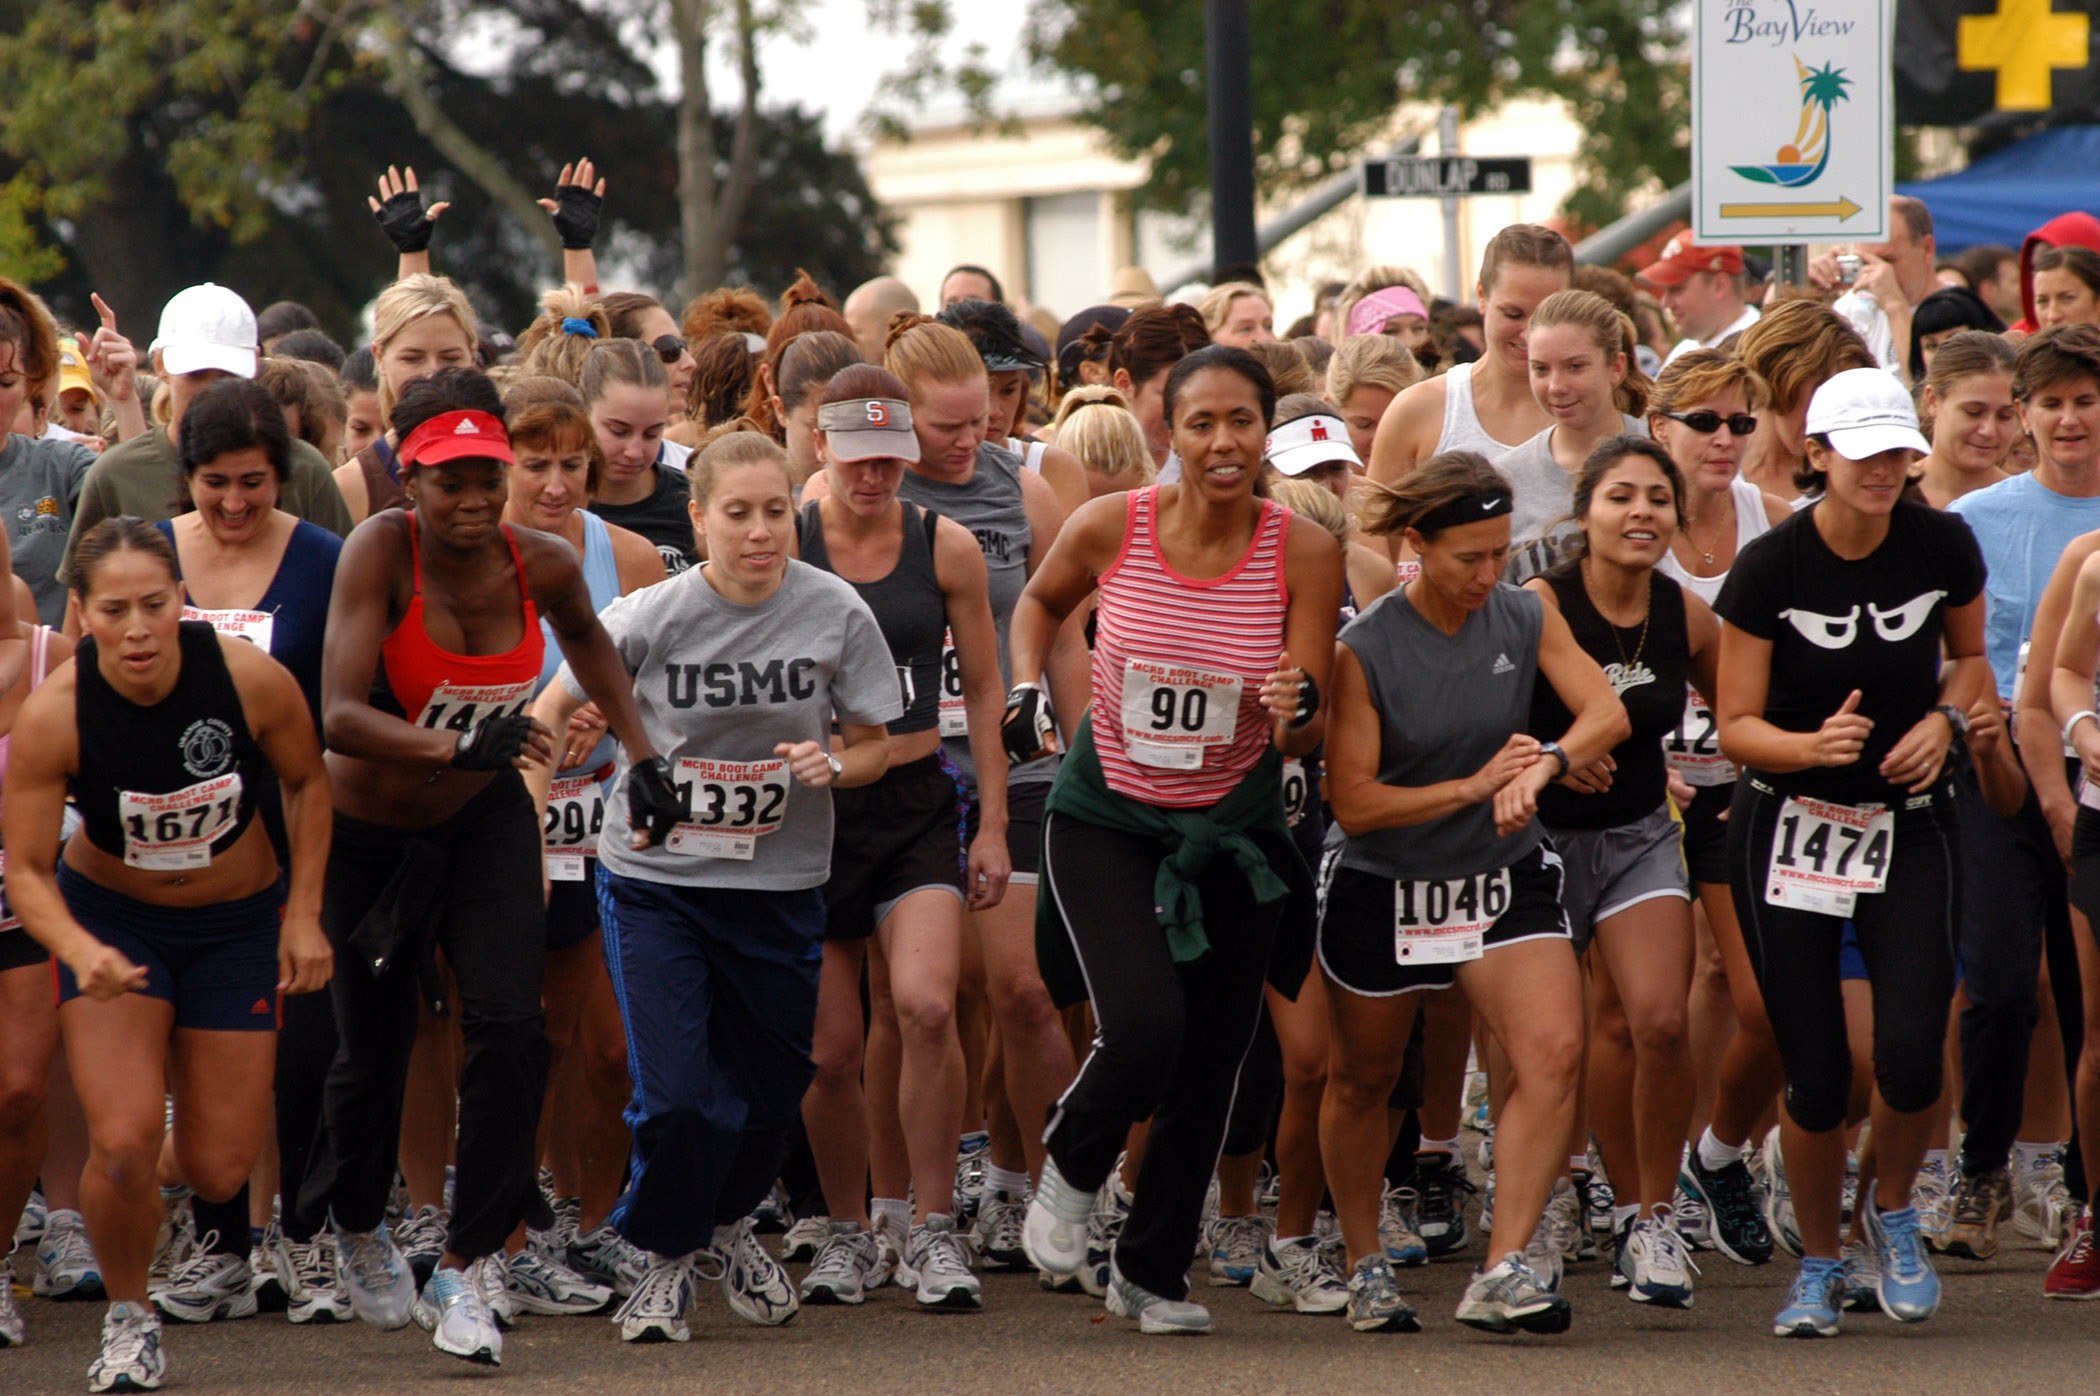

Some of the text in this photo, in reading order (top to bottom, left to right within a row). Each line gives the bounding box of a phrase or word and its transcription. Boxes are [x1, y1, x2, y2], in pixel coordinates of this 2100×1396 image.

[1385, 159, 1478, 194] DUNLAP
[973, 529, 1010, 562] SMC
[233, 613, 265, 623] CAMP
[665, 658, 816, 709] USMC
[944, 649, 962, 697] 8
[1132, 662, 1235, 685] MCRD BOOT CAMP
[1150, 675, 1214, 689] CHALLENGE
[1603, 662, 1656, 687] Ride
[1150, 687, 1207, 731] 90
[682, 759, 783, 773] MCRD BOOT CAMP
[700, 770, 765, 782] CHALLENGE
[130, 795, 163, 804] MCRD
[200, 778, 233, 793] CAMP
[150, 793, 215, 812] CHALLENGE
[676, 780, 785, 827] 1332
[126, 797, 233, 843] 1671
[1829, 805, 1858, 819] BOOT
[1777, 815, 1889, 878] 1474
[1398, 868, 1506, 925] 1046
